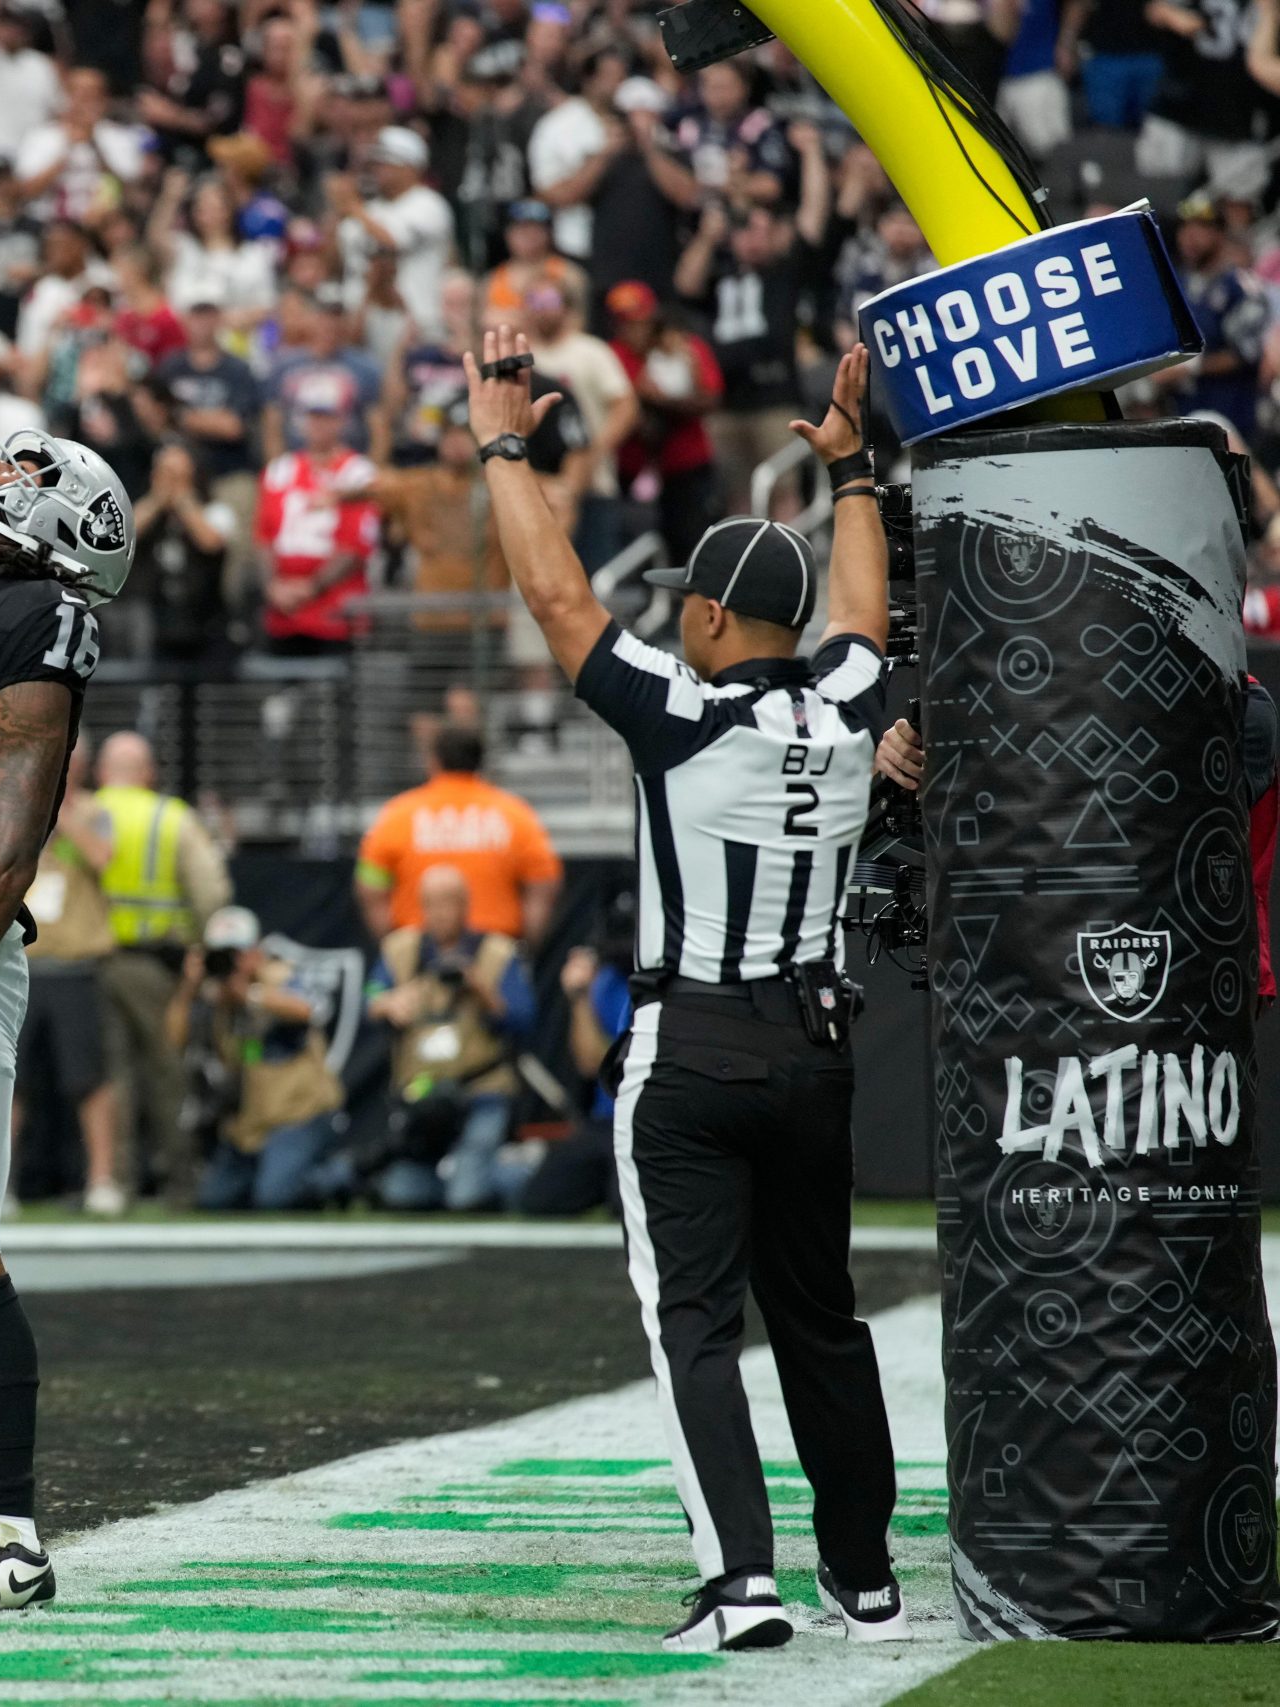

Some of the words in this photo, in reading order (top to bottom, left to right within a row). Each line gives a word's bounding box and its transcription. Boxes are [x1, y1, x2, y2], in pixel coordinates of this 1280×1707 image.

[873, 242, 1123, 368] CHOOSE
[915, 312, 1096, 415] LOVE
[42, 603, 100, 679] 16
[781, 744, 834, 777] BJ
[783, 783, 819, 837] 2
[1089, 937, 1161, 950] RAIDERS
[996, 1043, 1240, 1168] LATINO
[1012, 1186, 1151, 1204] HERITAGE
[1167, 1184, 1239, 1200] MONTH
[857, 1585, 892, 1611] NIKE
